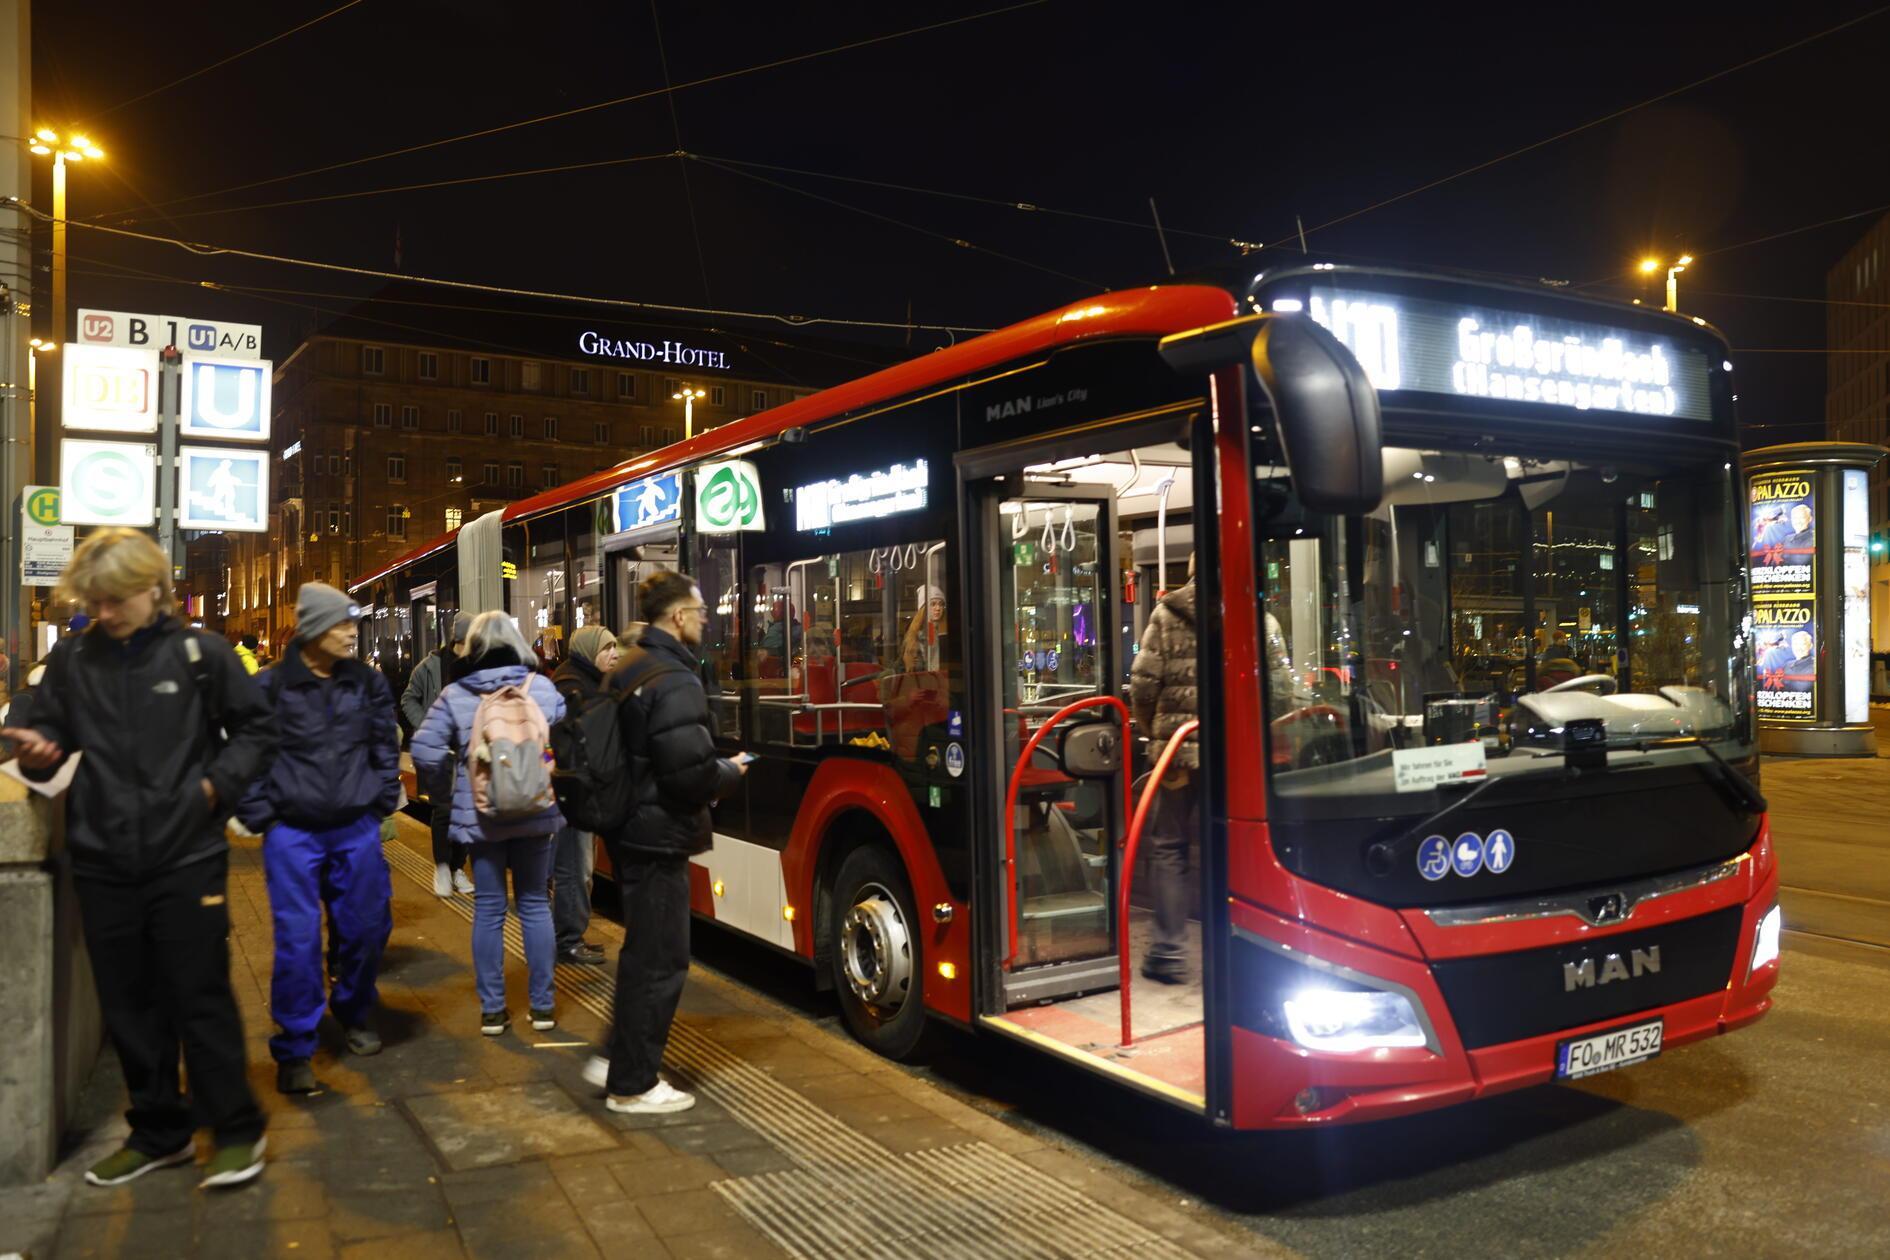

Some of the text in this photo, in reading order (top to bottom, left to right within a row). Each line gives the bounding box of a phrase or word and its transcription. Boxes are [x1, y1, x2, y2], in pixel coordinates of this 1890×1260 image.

[84, 316, 257, 351] U2 B 1 U1 A/B
[197, 365, 257, 428] U
[986, 395, 1032, 422] MAN
[1067, 388, 1088, 403] City
[38, 496, 60, 518] H
[1757, 481, 1811, 501] PALAZZO
[1757, 608, 1811, 624] PALAZZO
[1563, 945, 1661, 992] MAN
[1568, 1042, 1593, 1071] FO
[1603, 1034, 1627, 1062] MR
[1629, 1026, 1661, 1055] 532
